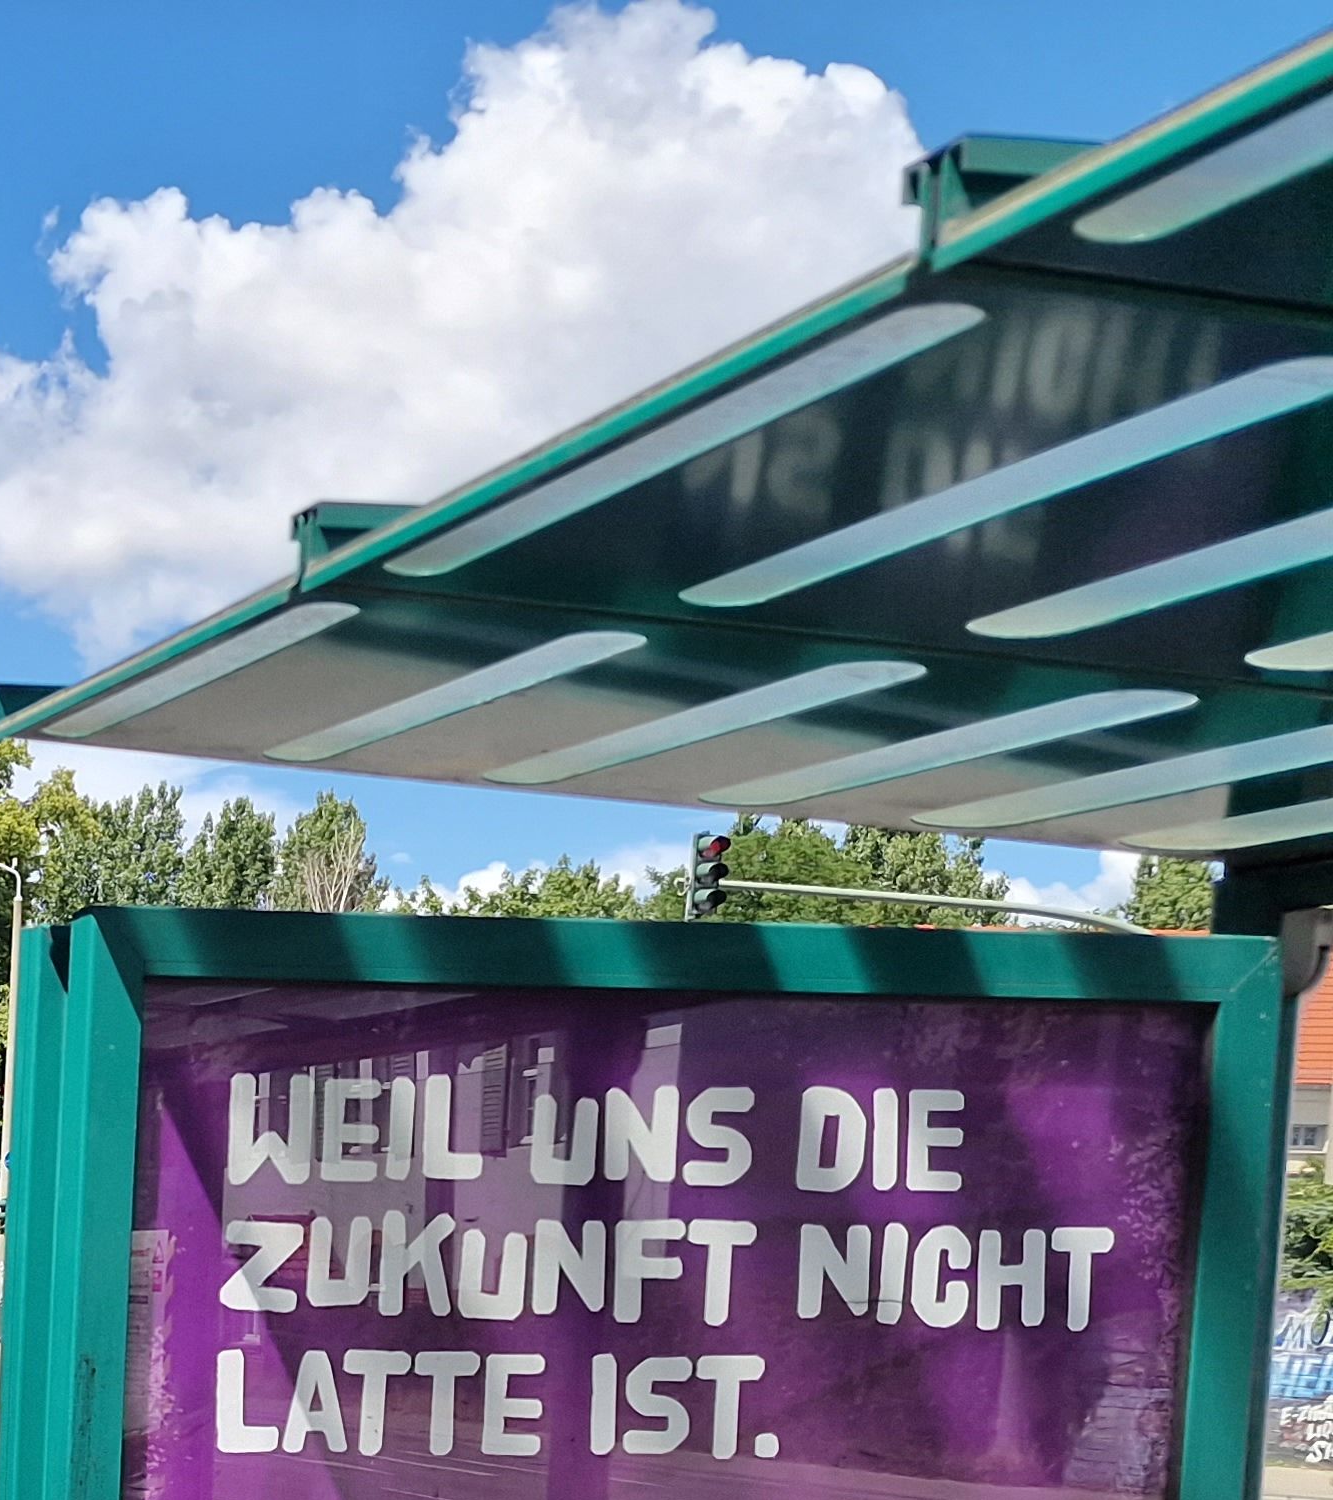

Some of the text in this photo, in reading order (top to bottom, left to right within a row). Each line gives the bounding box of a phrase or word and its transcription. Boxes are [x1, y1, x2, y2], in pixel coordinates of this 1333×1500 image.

[226, 1072, 966, 1193] WEIL UNS DIE
[221, 1209, 1115, 1332] ZUKUNFT NICHT
[215, 1349, 780, 1460] LATTE IST.
